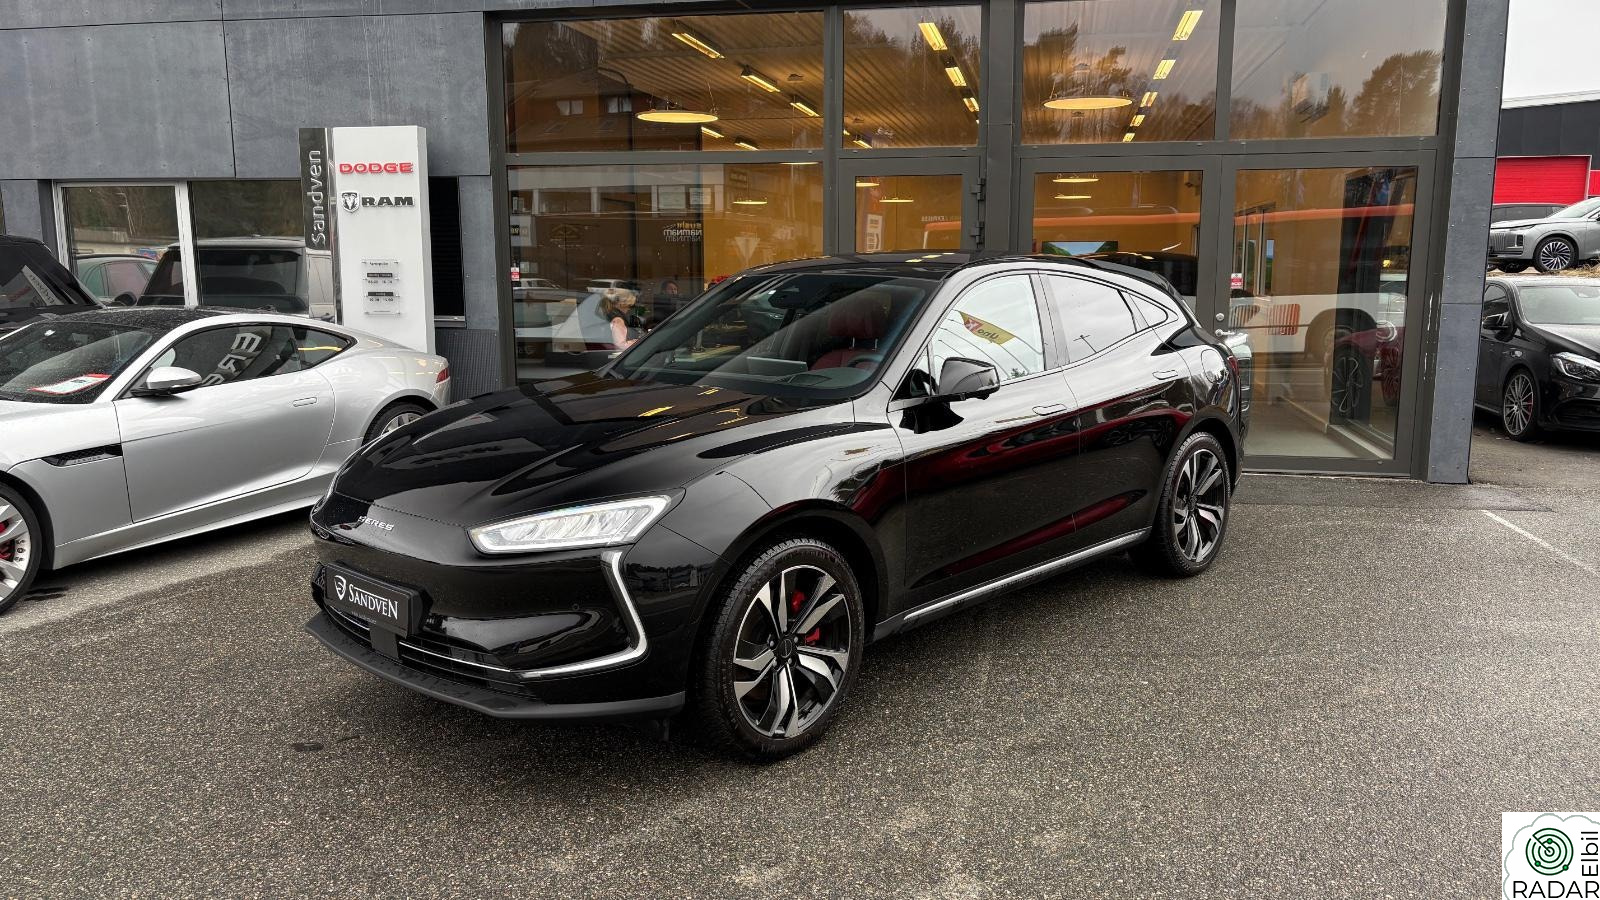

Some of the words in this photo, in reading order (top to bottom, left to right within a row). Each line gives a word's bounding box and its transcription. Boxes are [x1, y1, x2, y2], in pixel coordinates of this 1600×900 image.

[339, 162, 414, 174] DODGE
[306, 150, 326, 245] Sandven
[361, 196, 415, 207] RAM
[358, 515, 395, 531] SERES
[348, 583, 399, 620] SANDVEN
